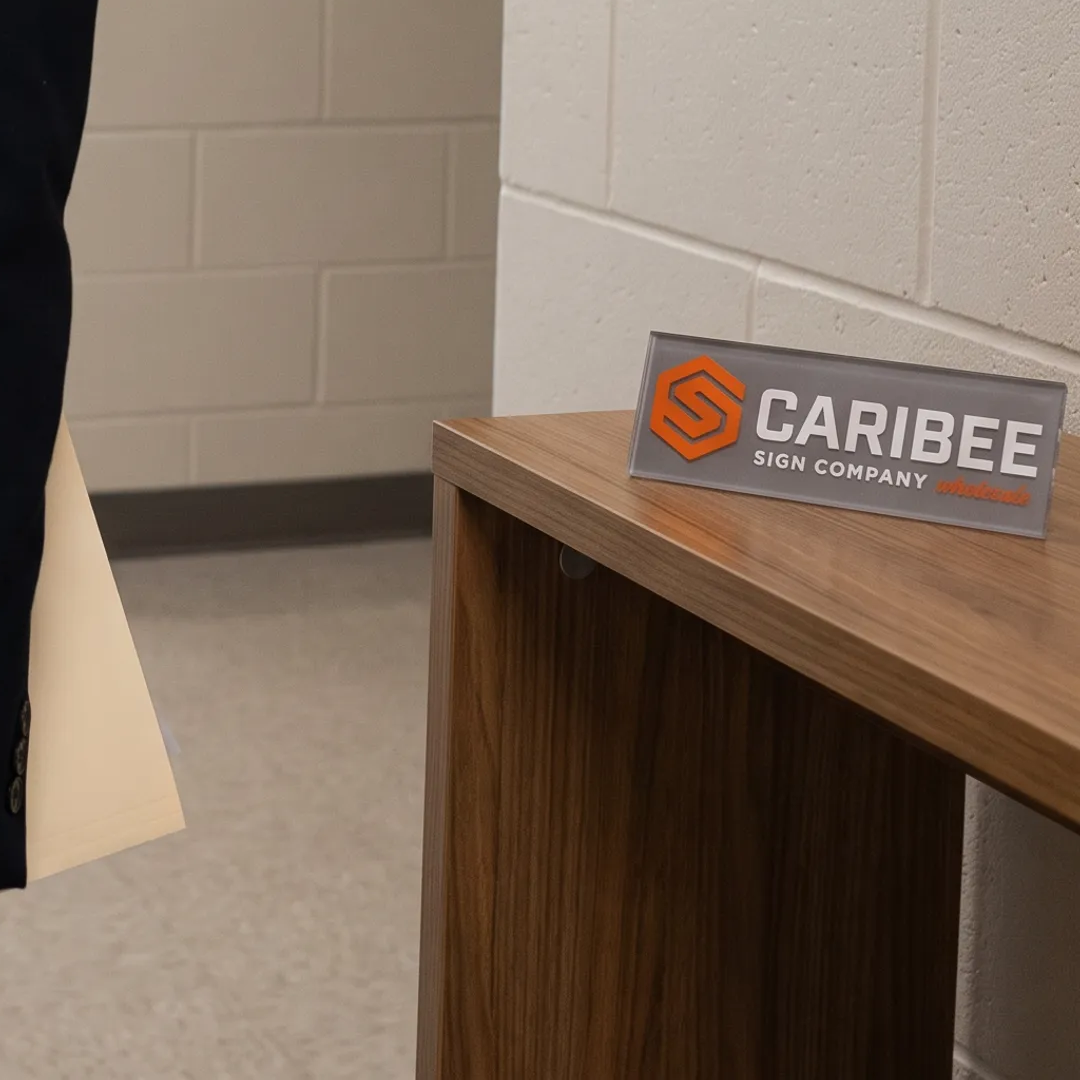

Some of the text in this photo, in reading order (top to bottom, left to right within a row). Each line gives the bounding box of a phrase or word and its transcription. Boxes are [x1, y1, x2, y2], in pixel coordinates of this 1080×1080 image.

[756, 388, 1043, 478] CARIBEE
[753, 450, 806, 472] SIGN
[814, 458, 928, 489] COMPANY
